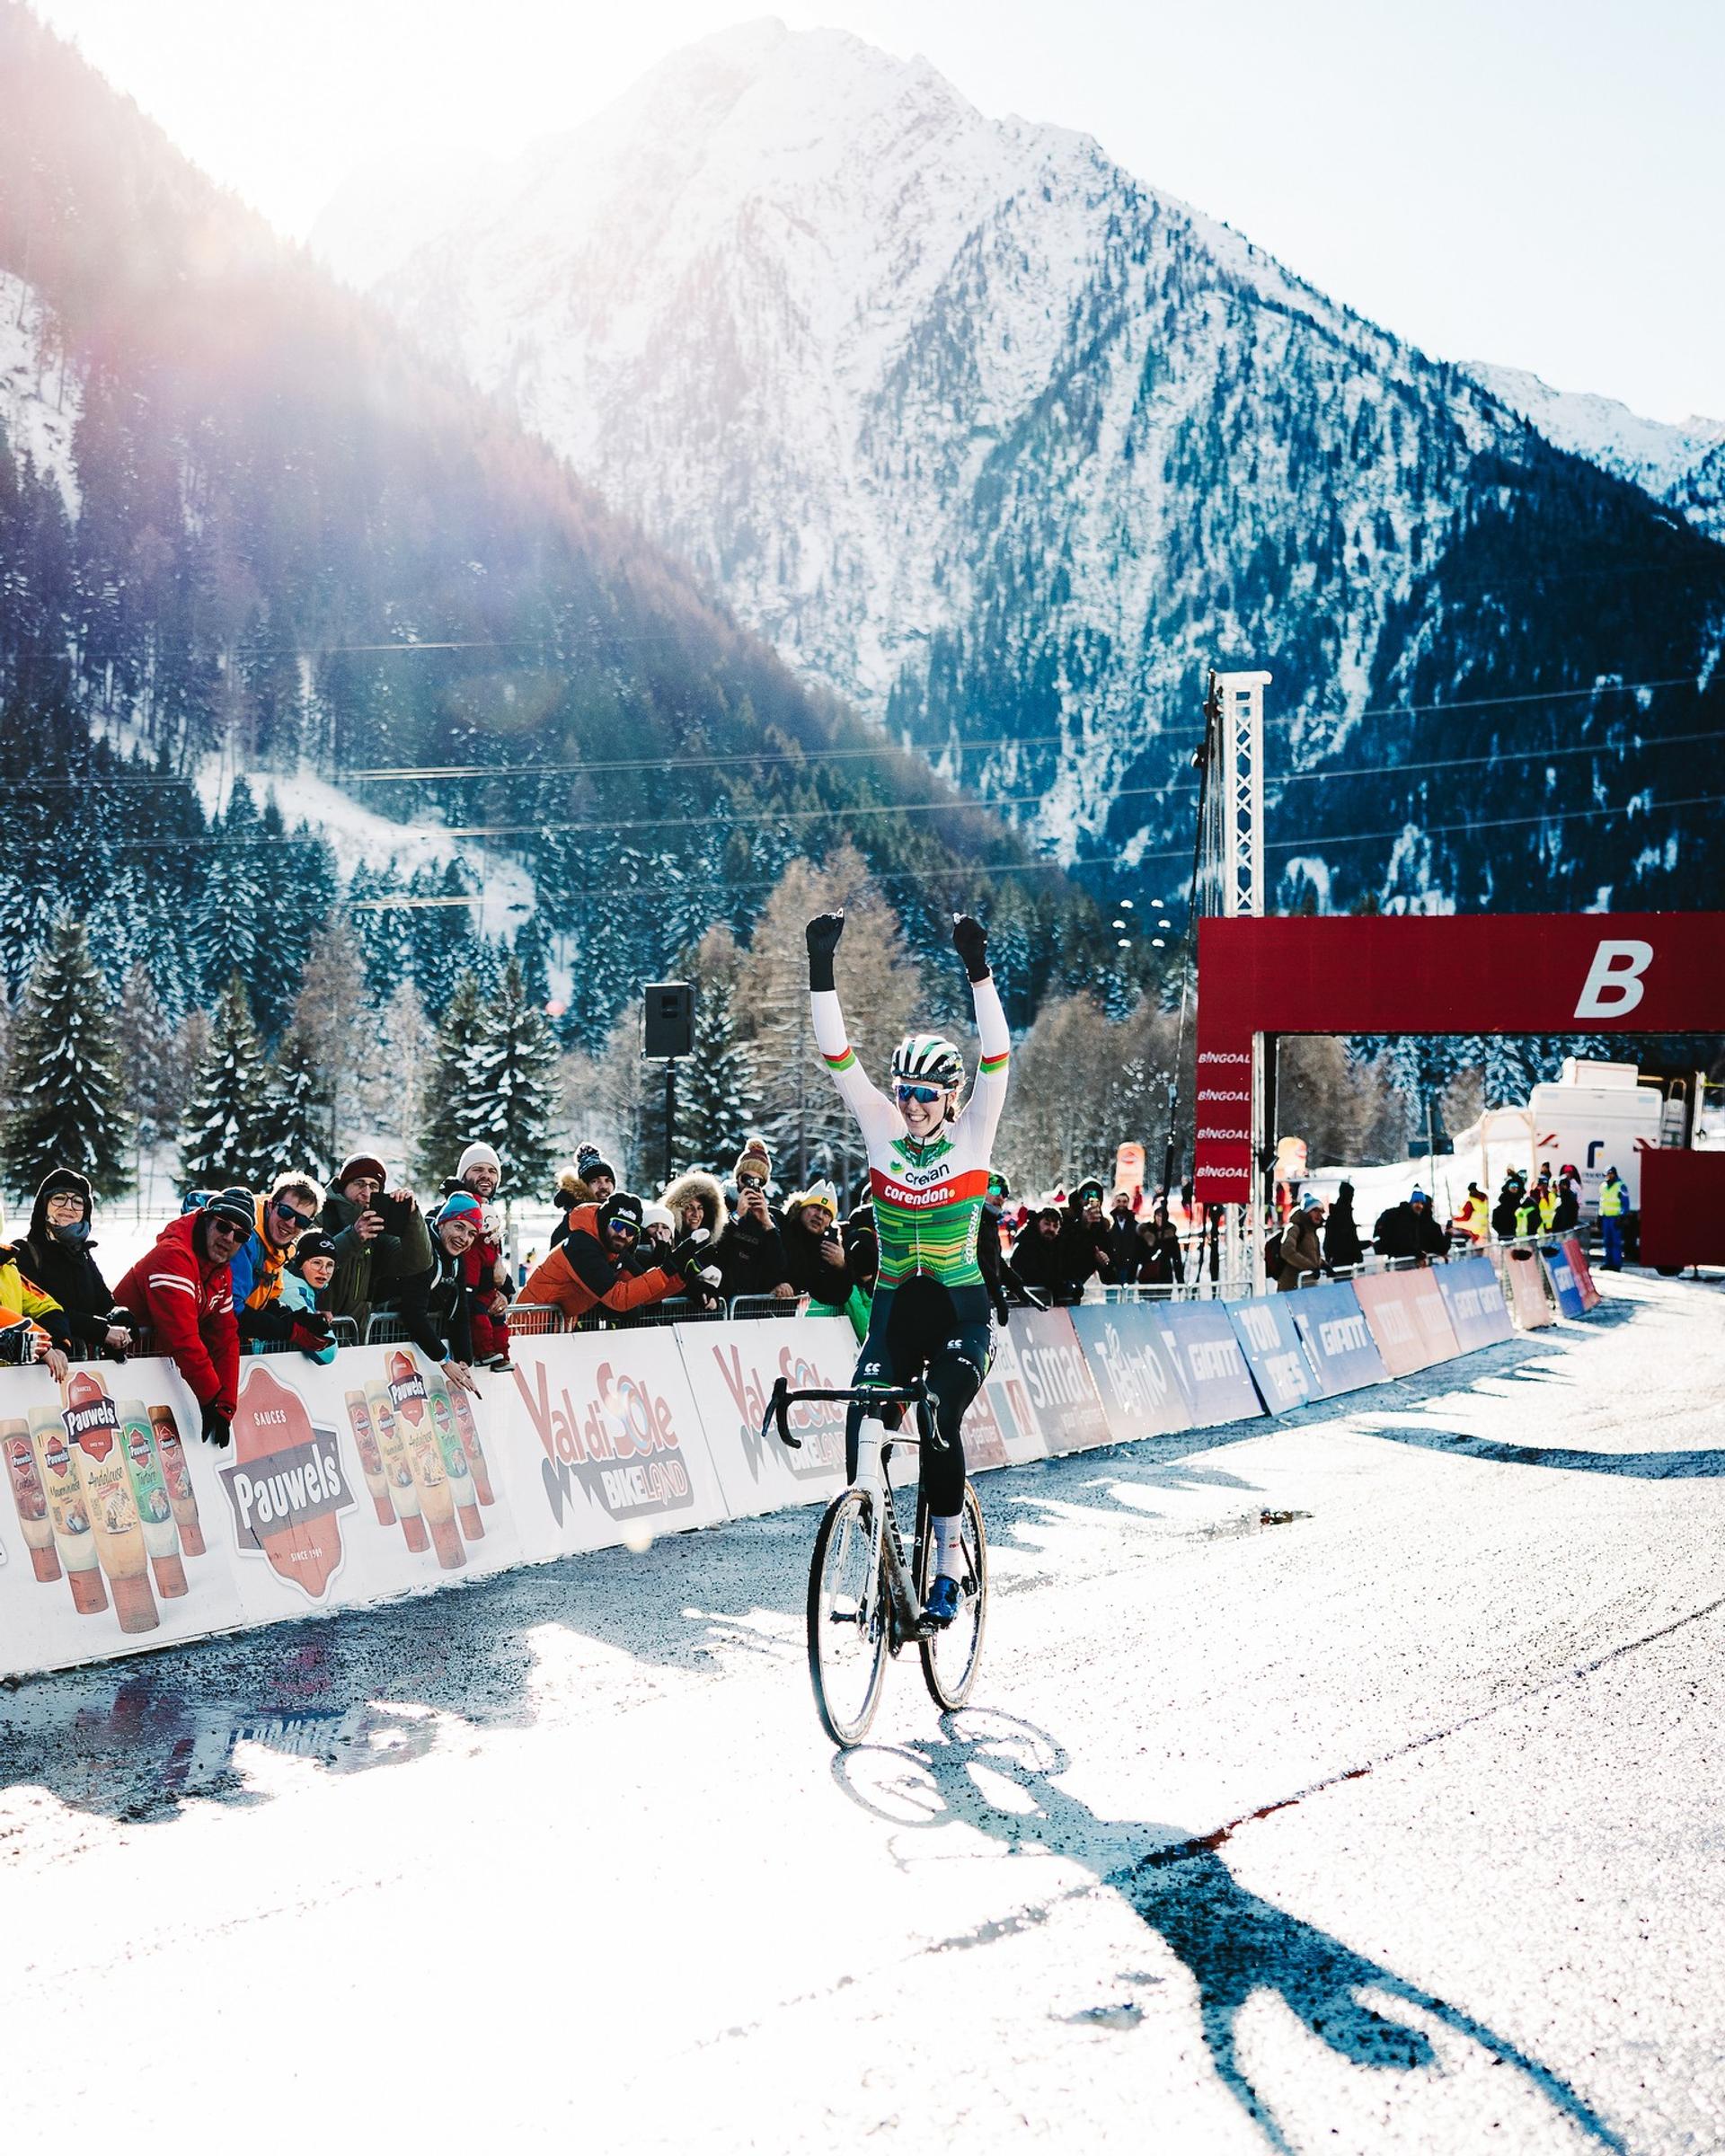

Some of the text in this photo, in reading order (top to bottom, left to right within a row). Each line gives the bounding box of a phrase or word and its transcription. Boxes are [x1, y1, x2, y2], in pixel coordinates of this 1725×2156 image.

[1573, 940, 1654, 1019] B
[883, 1183, 949, 1206] corendon
[1318, 1314, 1367, 1357] GIANT
[1021, 1327, 1094, 1409] simac
[1187, 1339, 1241, 1382] GIANT
[392, 1375, 426, 1406] Pauwels
[66, 1400, 116, 1436] Pauwels
[253, 1409, 287, 1427] SAUCES
[512, 1360, 679, 1468] Val di Sole
[233, 1443, 341, 1529] Pauwels
[883, 1488, 908, 1568] STEVENS
[290, 1554, 309, 1562] SINCE
